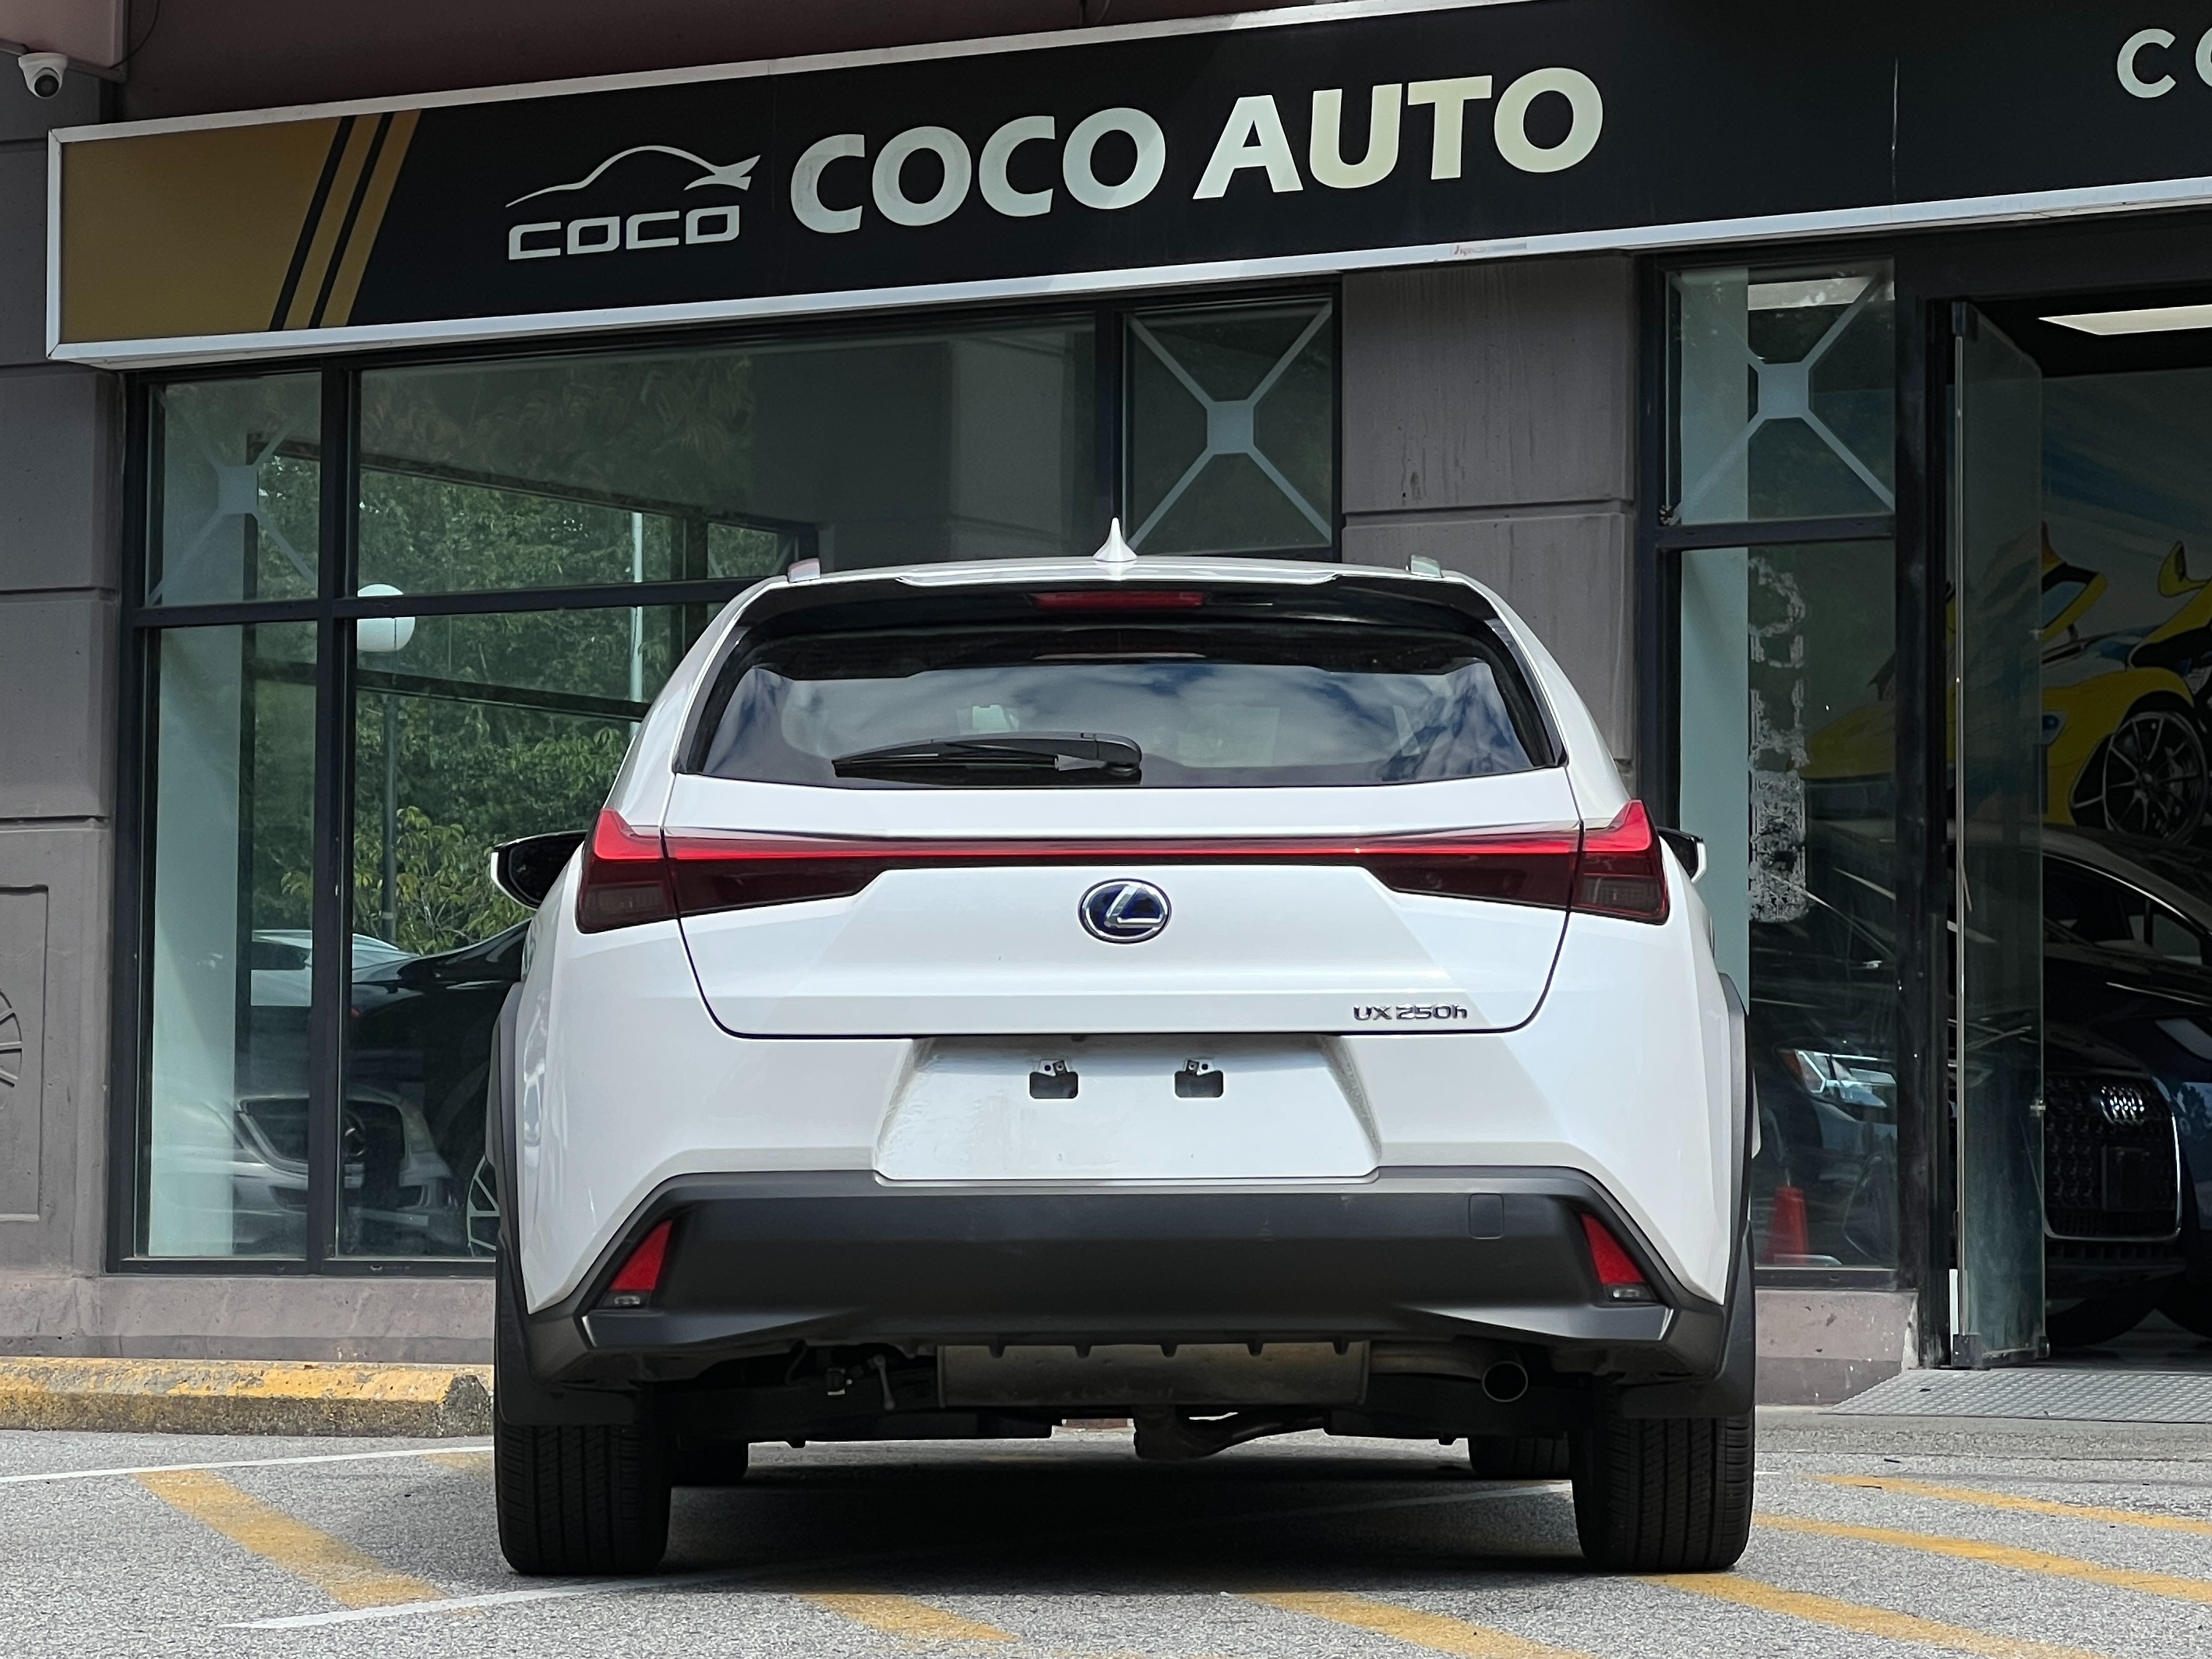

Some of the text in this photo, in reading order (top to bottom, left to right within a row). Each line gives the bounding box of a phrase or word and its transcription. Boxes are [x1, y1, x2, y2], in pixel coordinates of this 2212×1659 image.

[2116, 27, 2212, 99] C
[790, 67, 1603, 234] COCO AUTO
[509, 206, 739, 260] COCO
[1353, 1003, 1468, 1021] UX 250h
